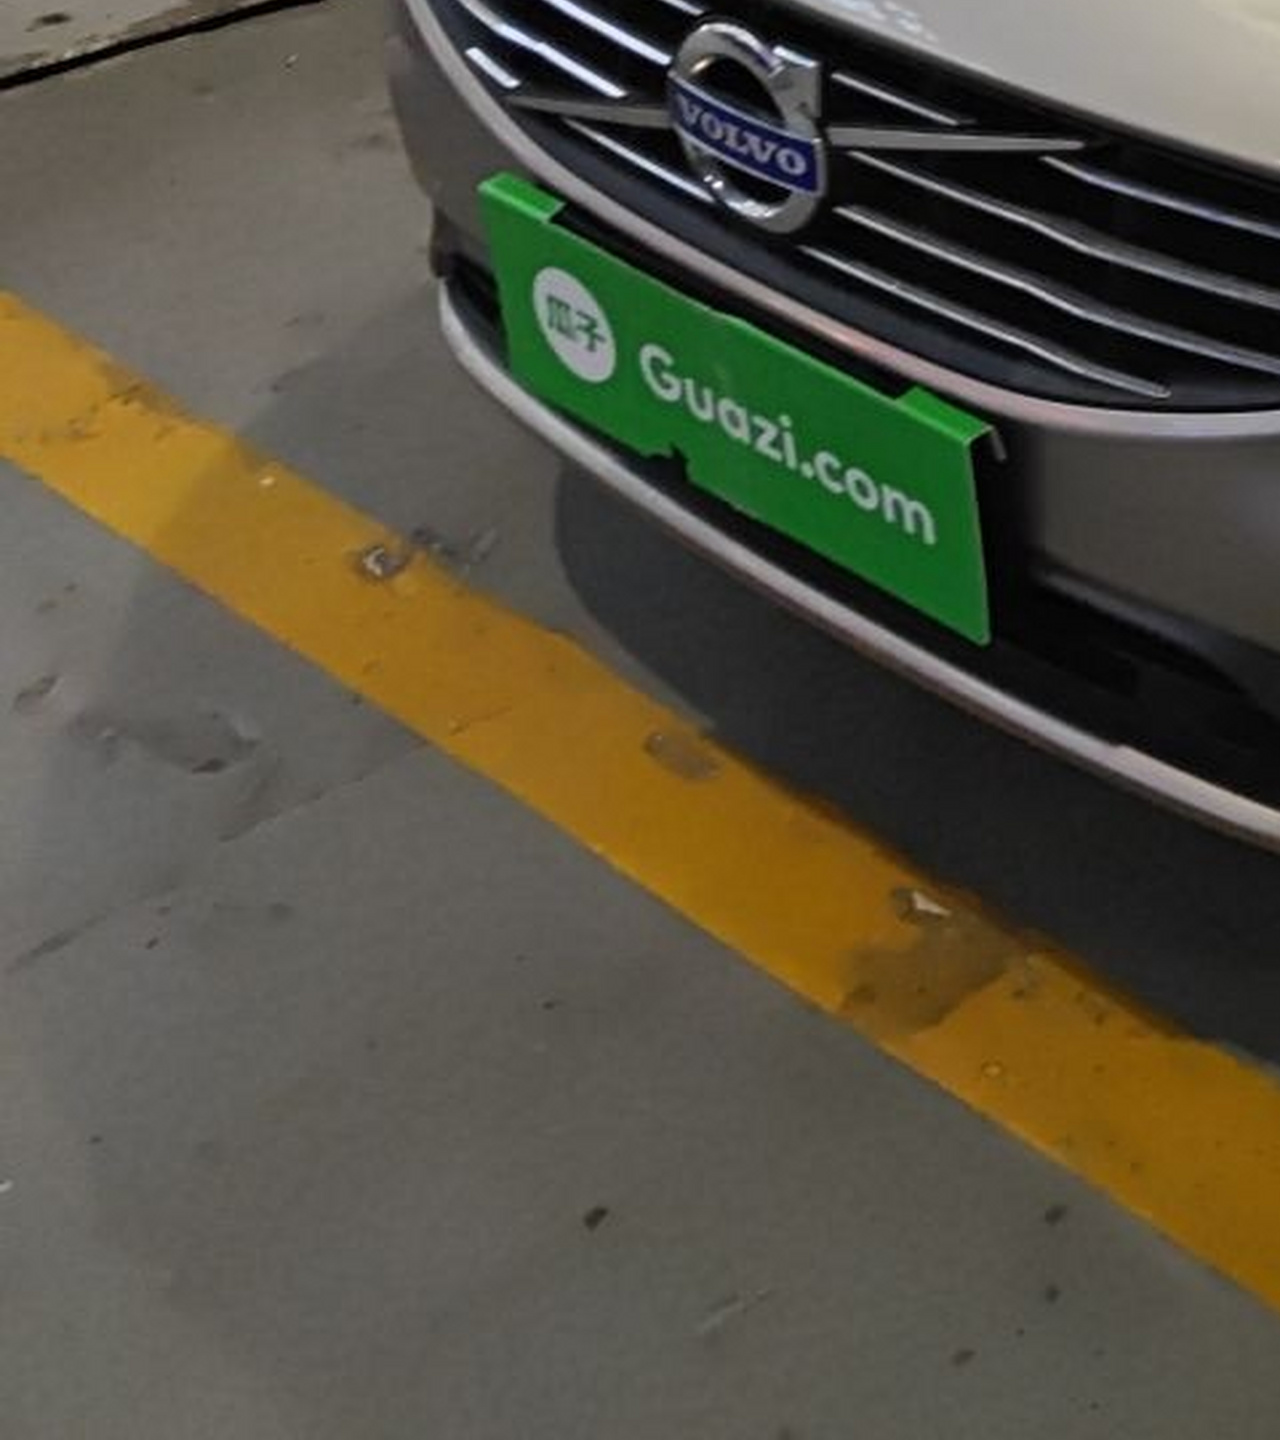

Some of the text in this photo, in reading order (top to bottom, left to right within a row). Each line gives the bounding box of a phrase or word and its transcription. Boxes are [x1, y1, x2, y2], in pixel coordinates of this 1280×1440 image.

[675, 92, 807, 176] VOLVO
[546, 294, 606, 353] 瓜子
[638, 343, 937, 545] Guazi.com
